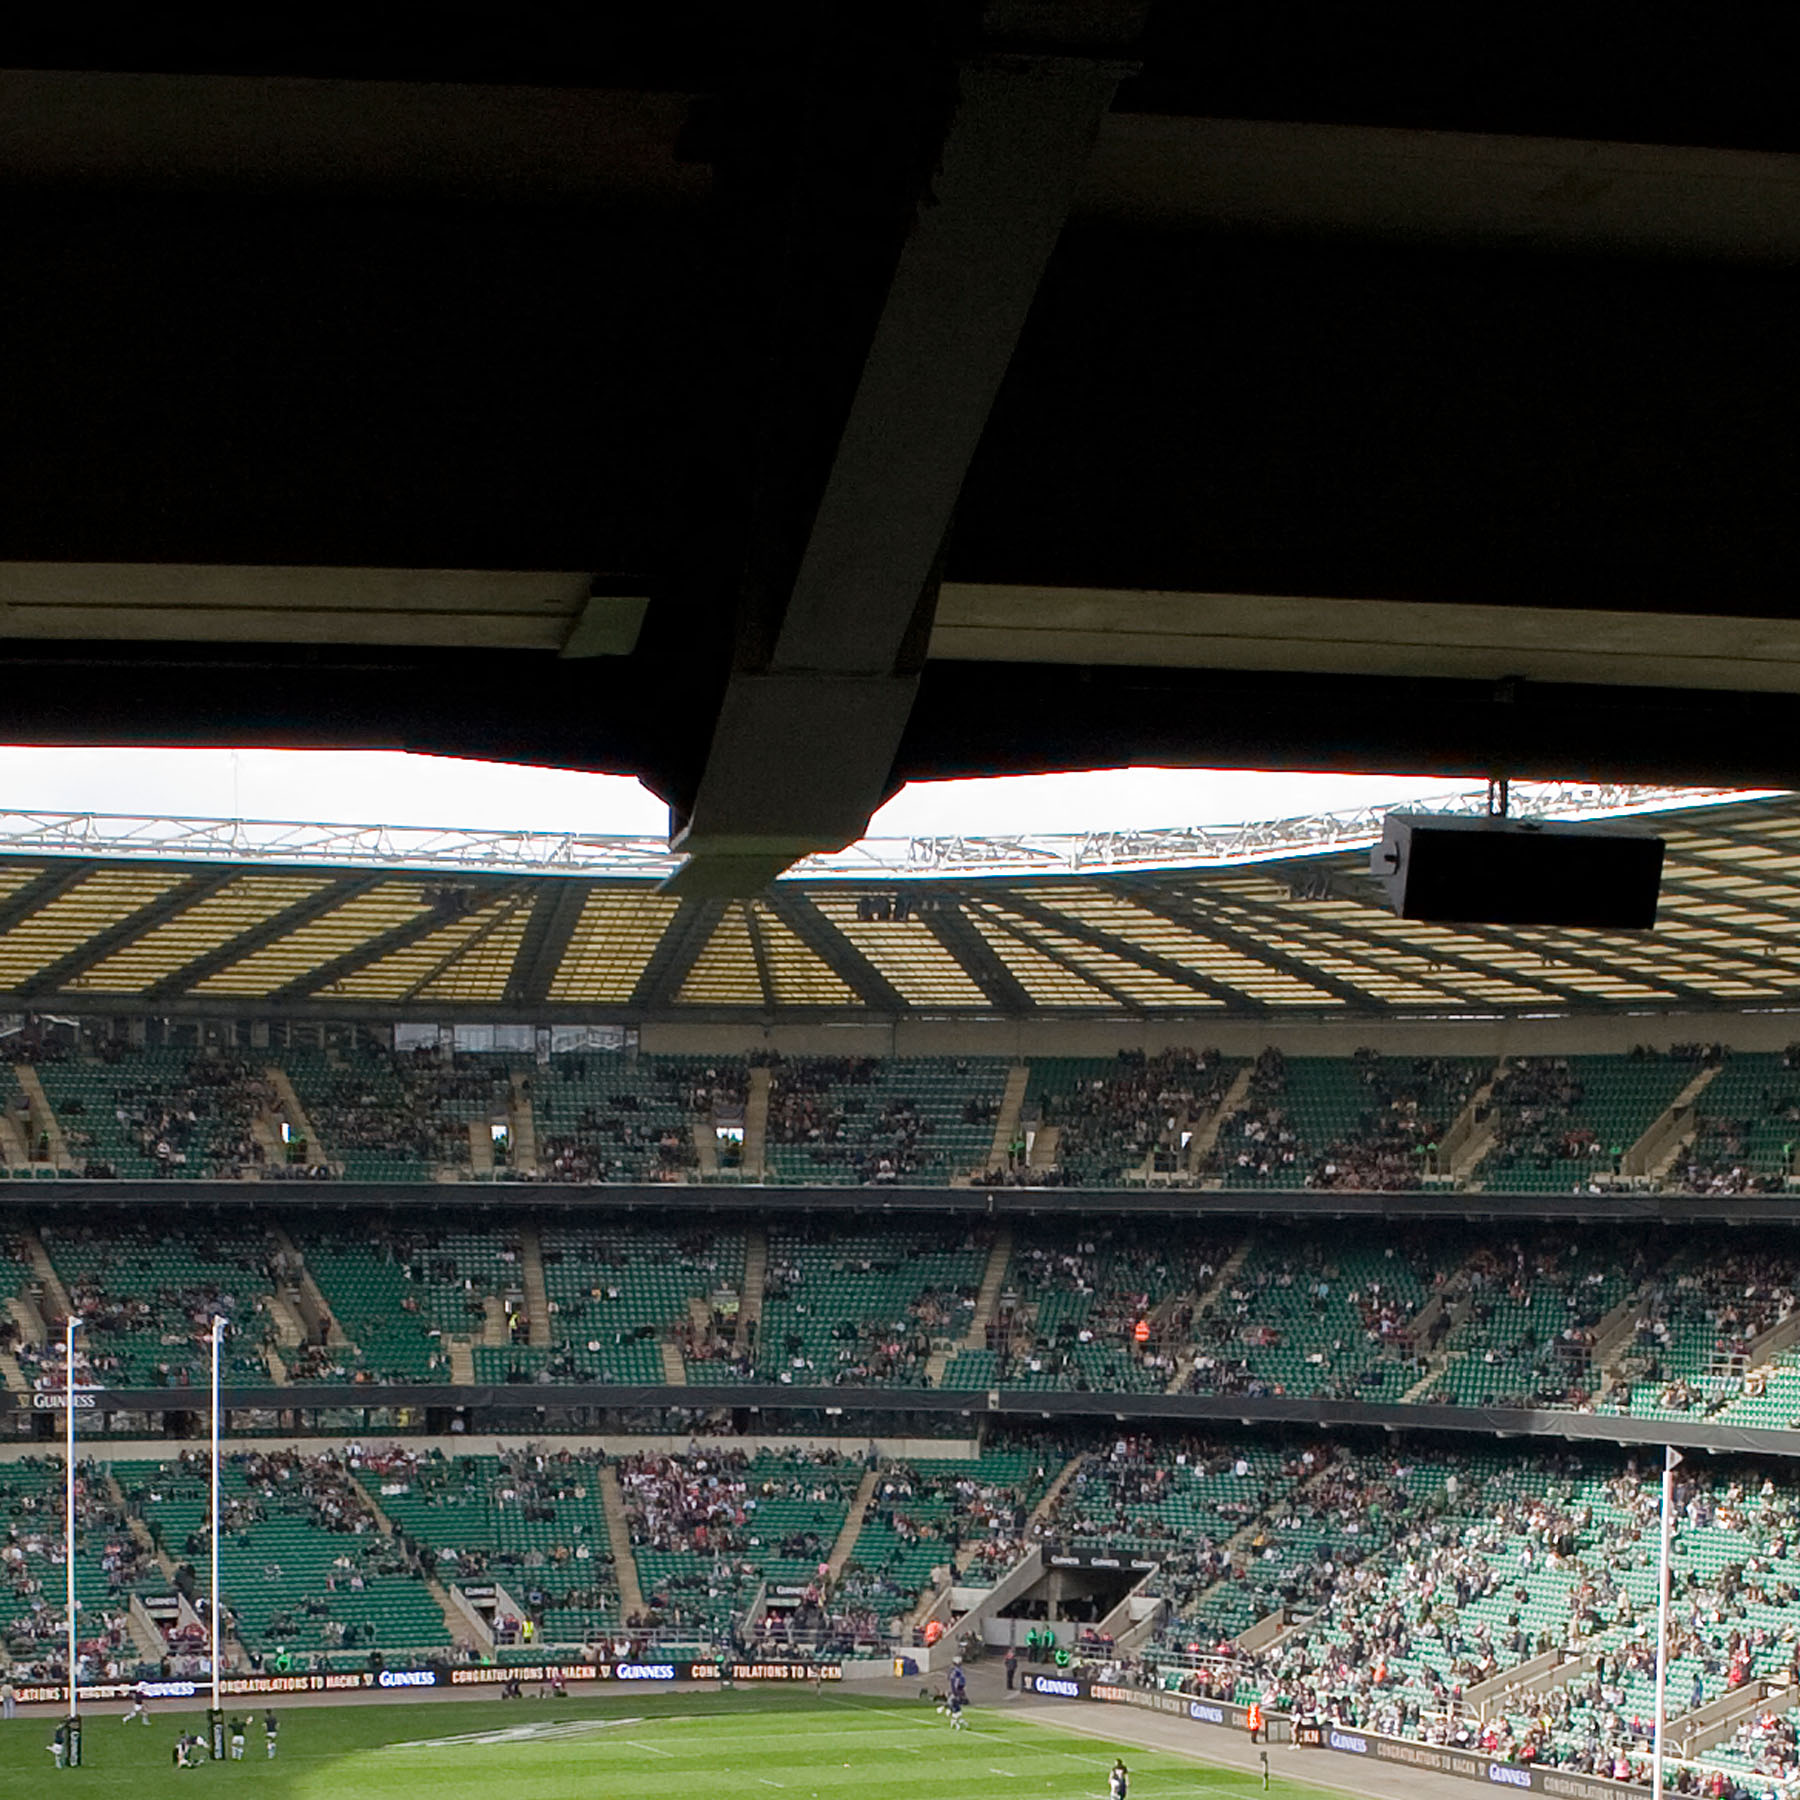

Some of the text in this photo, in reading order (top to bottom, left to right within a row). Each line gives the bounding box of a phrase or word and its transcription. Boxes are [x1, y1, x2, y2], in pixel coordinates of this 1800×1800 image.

[34, 1393, 96, 1409] GUINESS
[379, 1671, 436, 1687] GUINNESS
[452, 1666, 544, 1683] CONGRATULATIONS
[617, 1664, 675, 1680] GUINNESS
[692, 1664, 790, 1679] CONGTULATIONS
[792, 1665, 805, 1679] TO
[218, 1678, 308, 1695] ONGRATULATIONS
[310, 1677, 324, 1689] TO
[1036, 1675, 1080, 1697] GUINNESS
[1489, 1763, 1531, 1787] GUINNESS
